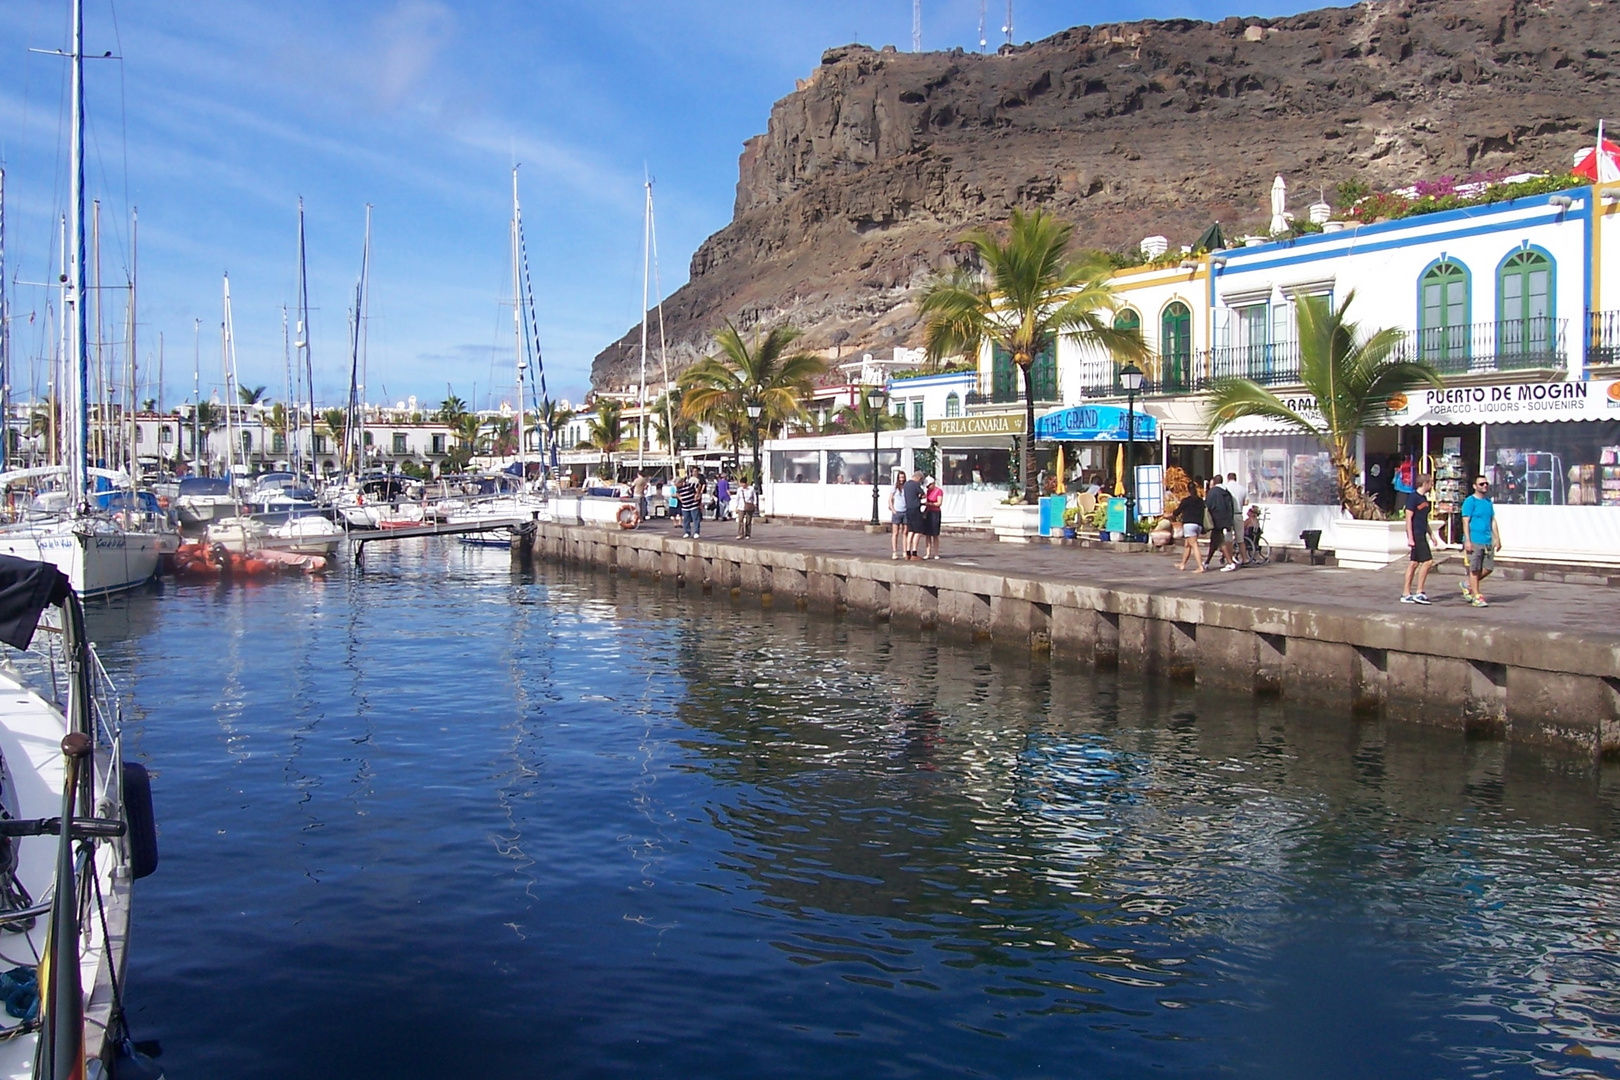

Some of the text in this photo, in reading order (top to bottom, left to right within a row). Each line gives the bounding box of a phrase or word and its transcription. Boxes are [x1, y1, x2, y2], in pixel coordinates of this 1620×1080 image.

[1427, 382, 1587, 404] PUERTO DE MOGAN
[1429, 403, 1471, 414] TOBACCO
[1479, 402, 1520, 413] LIQUORS
[1527, 400, 1585, 411] SOUVENIRS
[940, 418, 1009, 433] PERLA CANARIA
[1044, 414, 1063, 434] THE
[1066, 409, 1098, 430] GRAND
